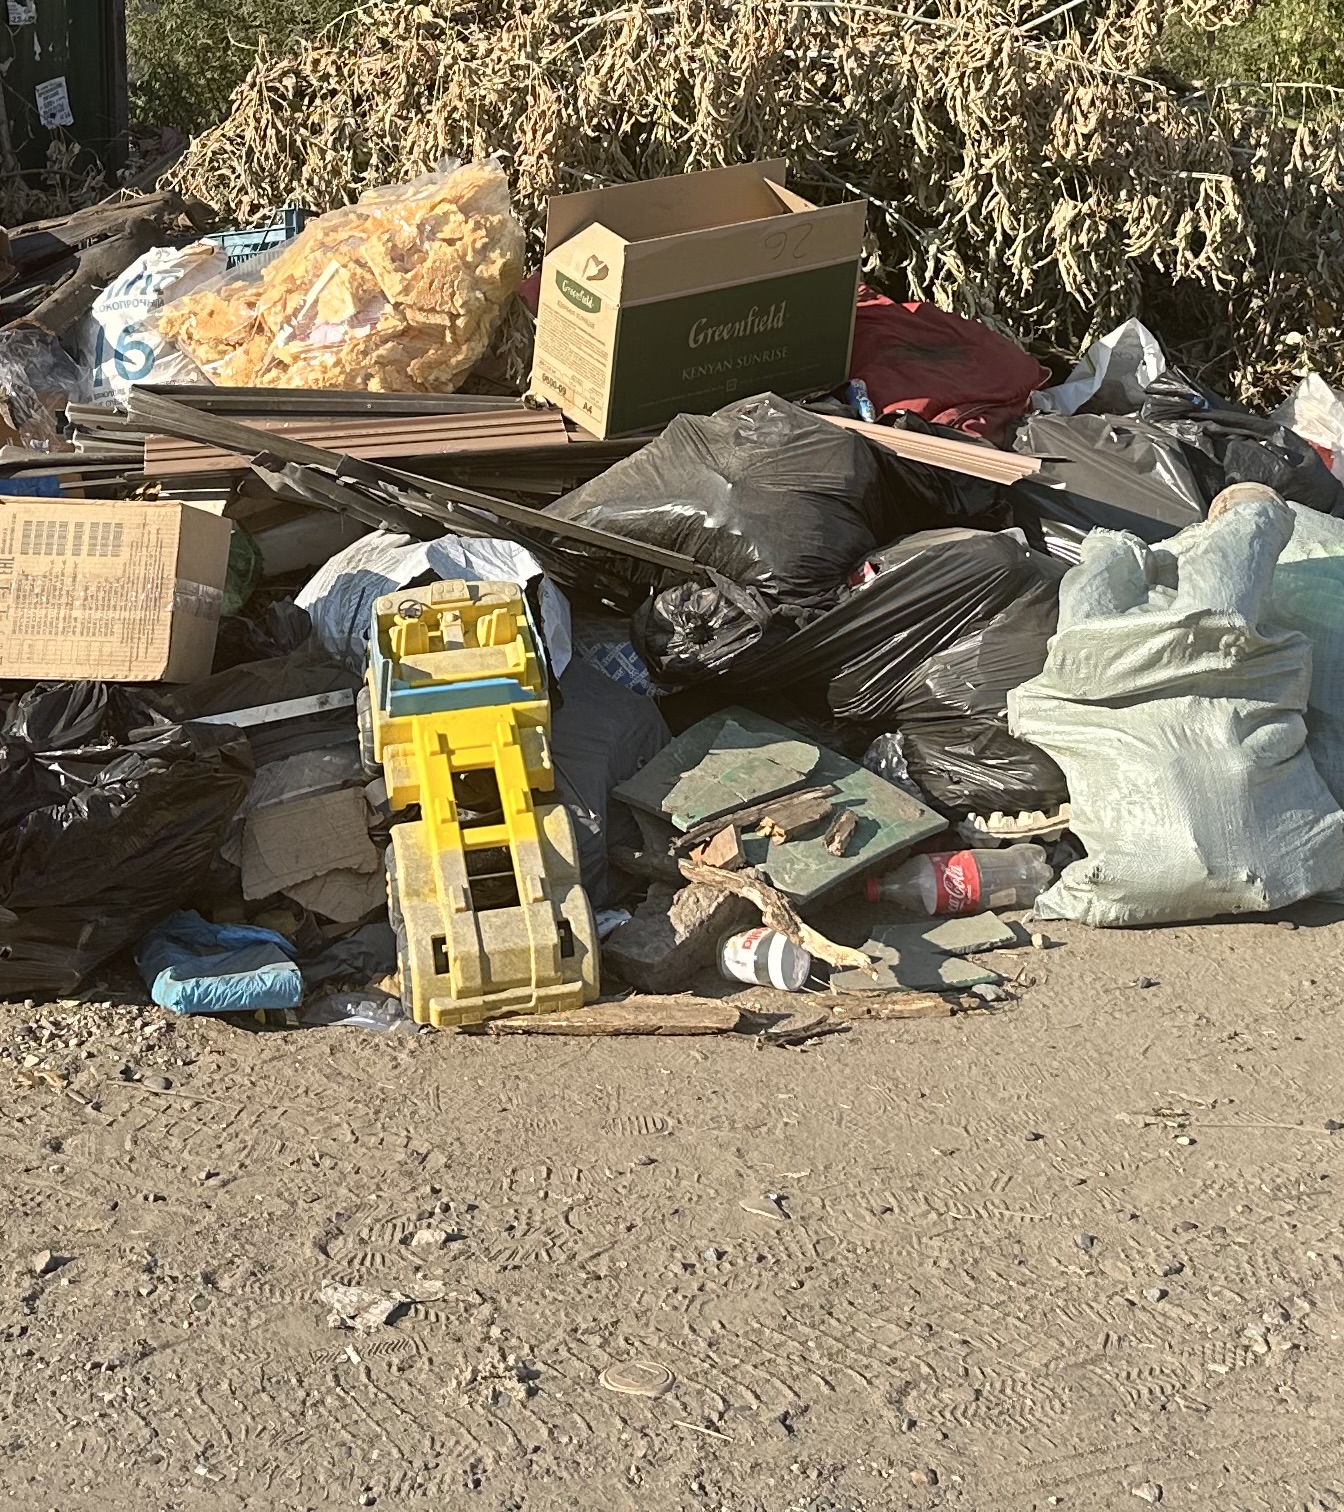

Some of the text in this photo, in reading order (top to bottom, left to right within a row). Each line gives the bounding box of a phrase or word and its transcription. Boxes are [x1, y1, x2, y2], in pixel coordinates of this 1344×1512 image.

[688, 300, 787, 349] Greenfield
[681, 346, 789, 381] KENYAN SUNRISE
